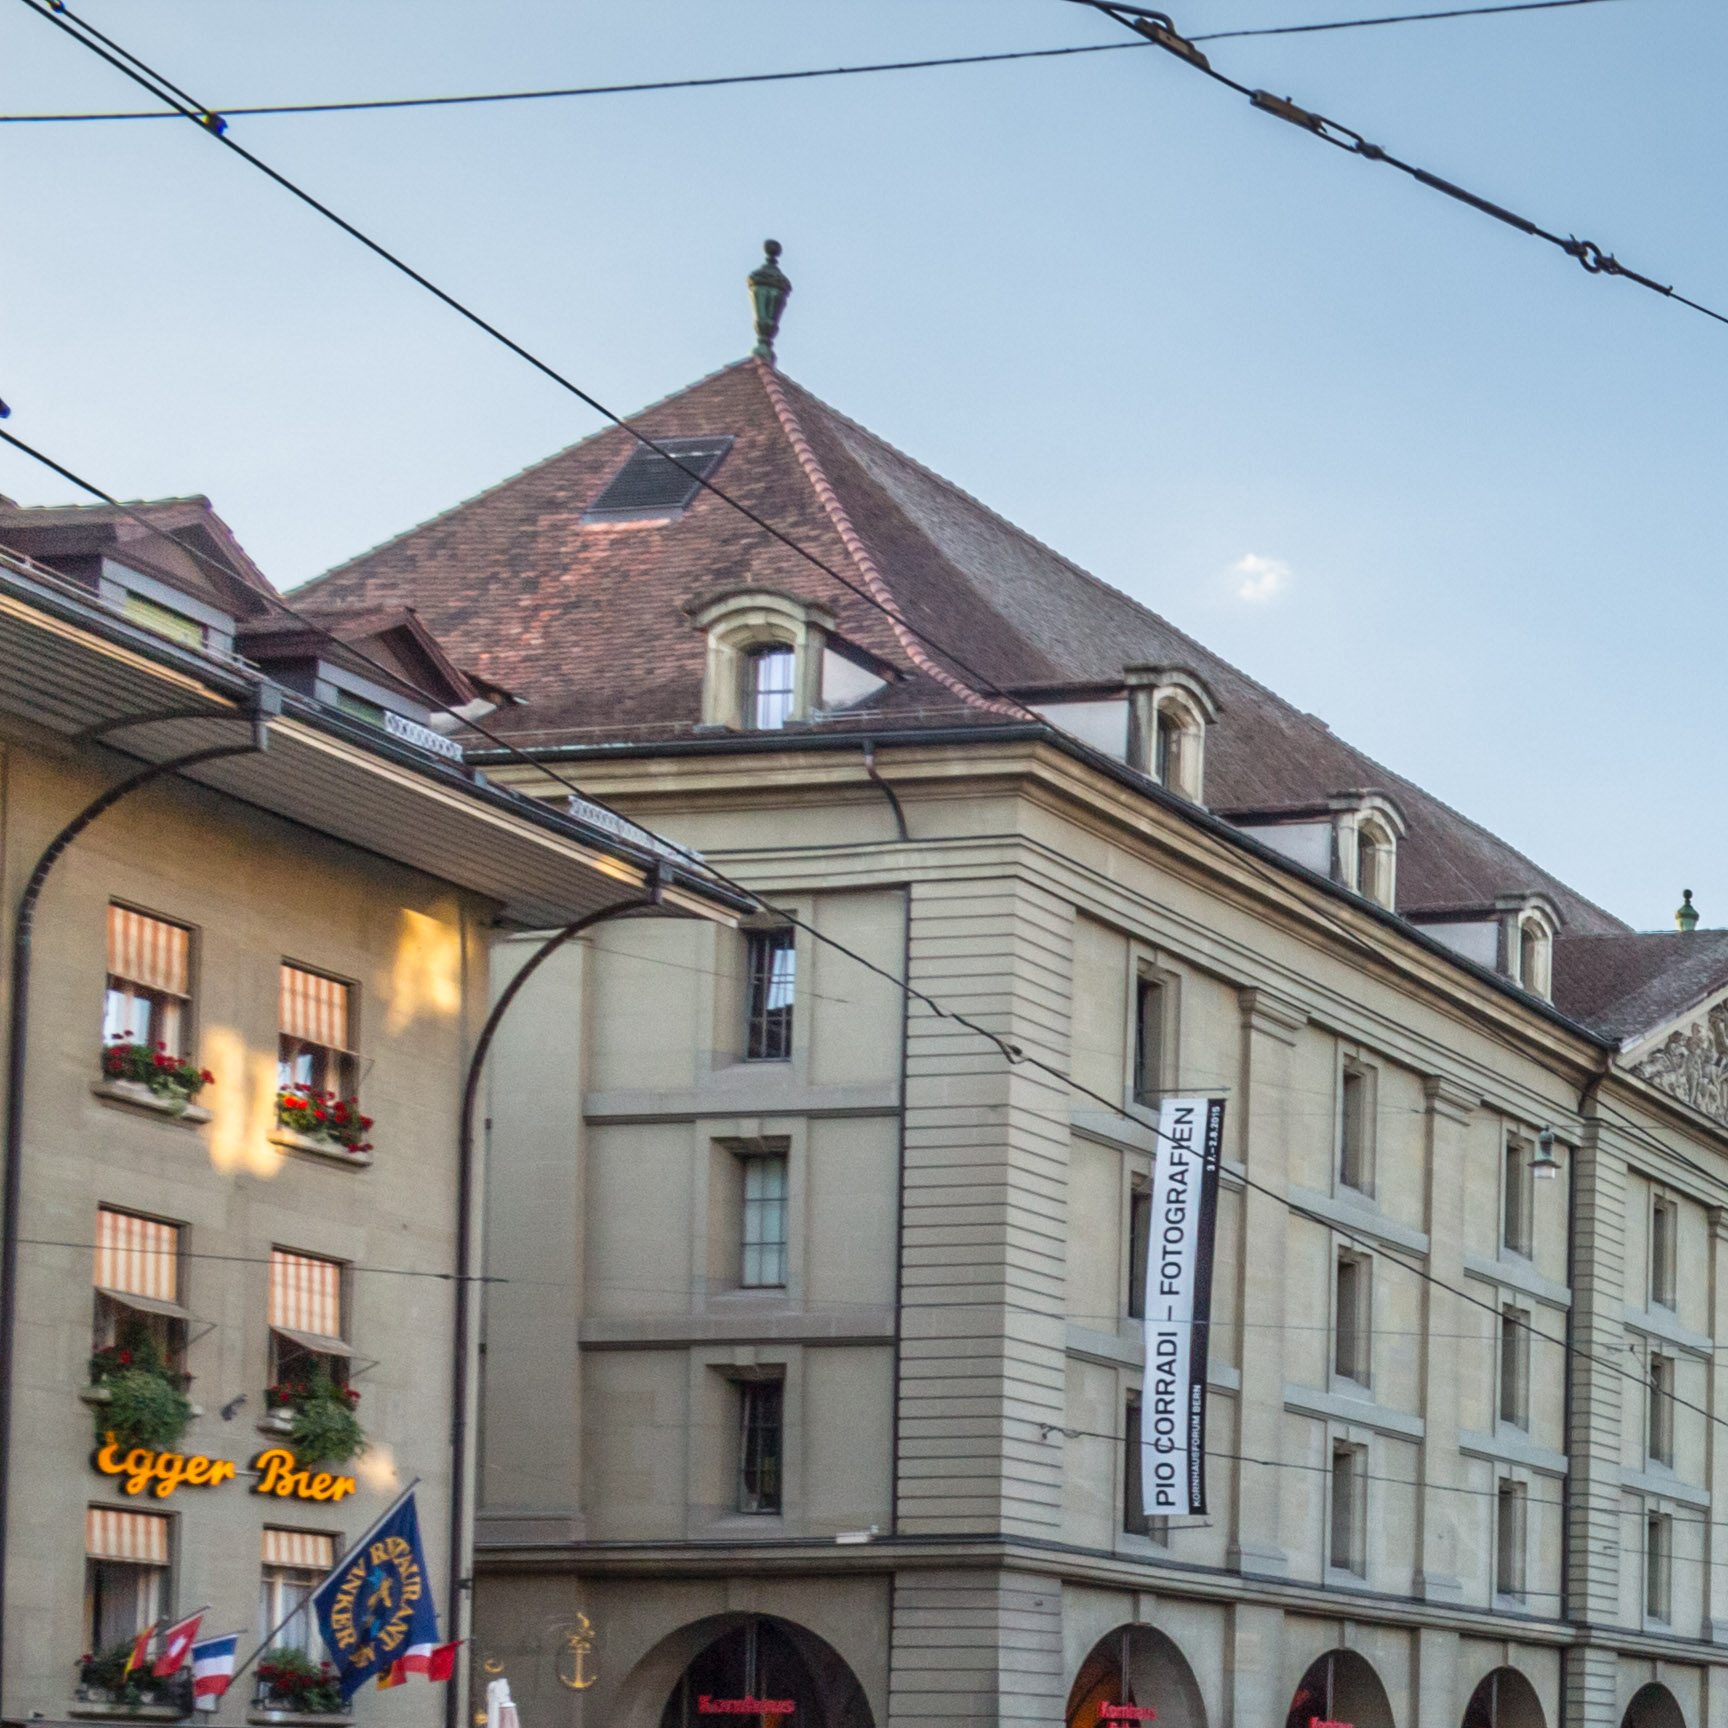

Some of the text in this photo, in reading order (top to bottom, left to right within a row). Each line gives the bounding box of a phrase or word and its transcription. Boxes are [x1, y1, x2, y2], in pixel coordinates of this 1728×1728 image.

[1160, 1107, 1195, 1297] FOTOGRAFIEN
[1154, 1331, 1178, 1454] CORRADI
[1191, 1384, 1202, 1413] BERN
[97, 1431, 356, 1500] Egger Bier
[1155, 1462, 1176, 1507] PIO
[331, 1557, 366, 1649] ANKER
